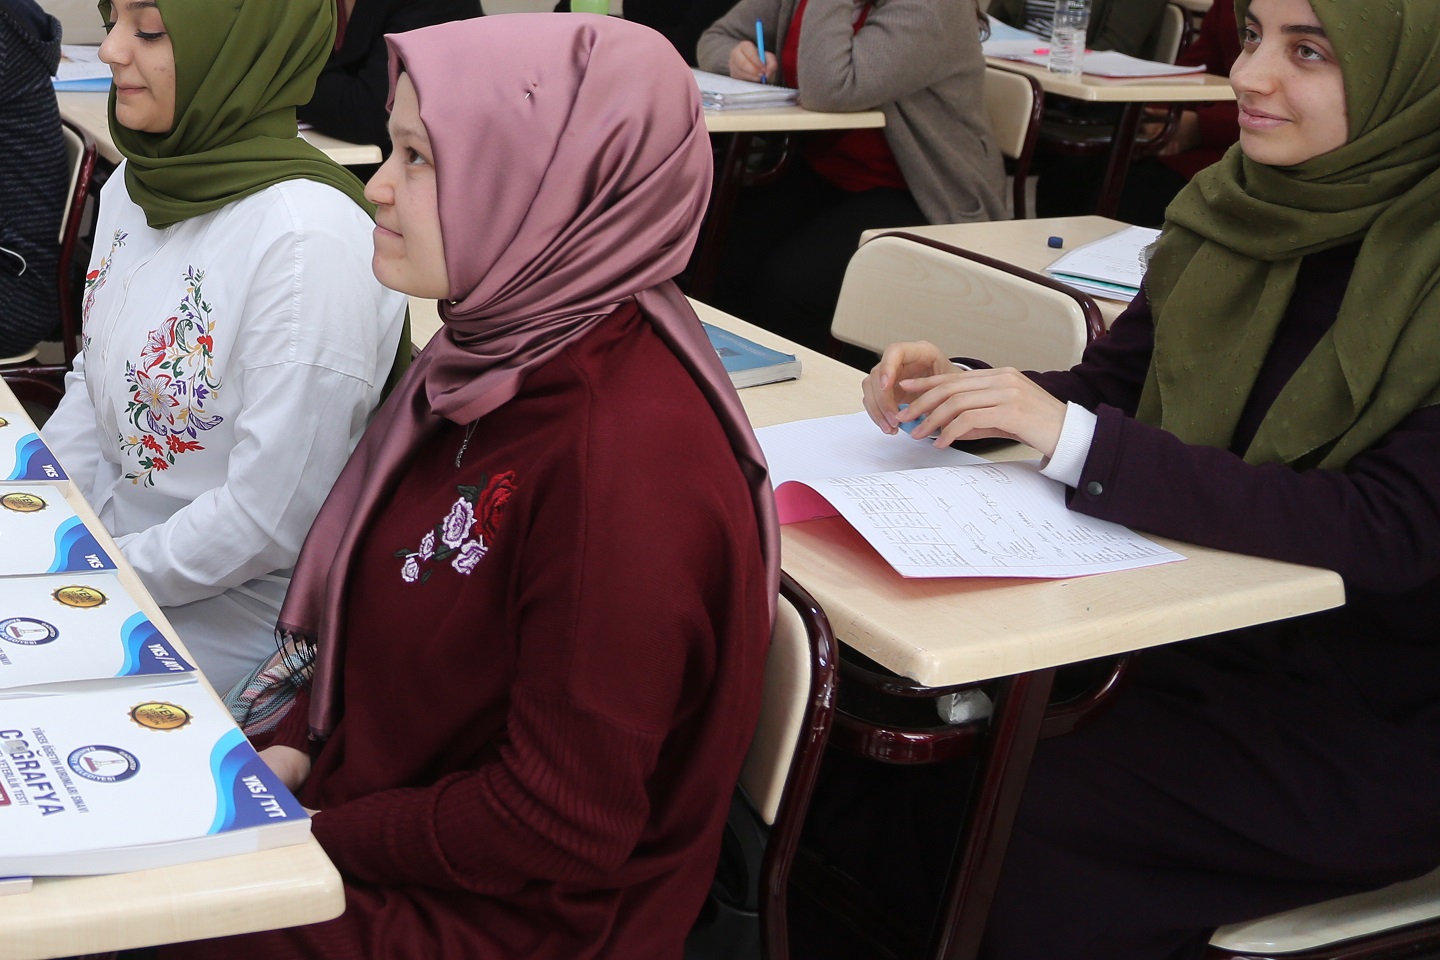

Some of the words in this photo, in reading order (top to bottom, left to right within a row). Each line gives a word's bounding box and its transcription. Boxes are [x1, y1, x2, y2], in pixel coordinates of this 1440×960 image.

[42, 464, 58, 477] YKS
[85, 554, 104, 568] YKS
[76, 589, 99, 601] YENİ
[148, 644, 169, 656] YKS
[155, 705, 182, 721] YENİ
[31, 727, 48, 744] YÜKSEK
[53, 766, 78, 795] KURUMLARI
[70, 795, 89, 813] SINAVI
[10, 789, 32, 805] TESTİ
[242, 775, 267, 793] YKS
[260, 799, 287, 817] TYT
